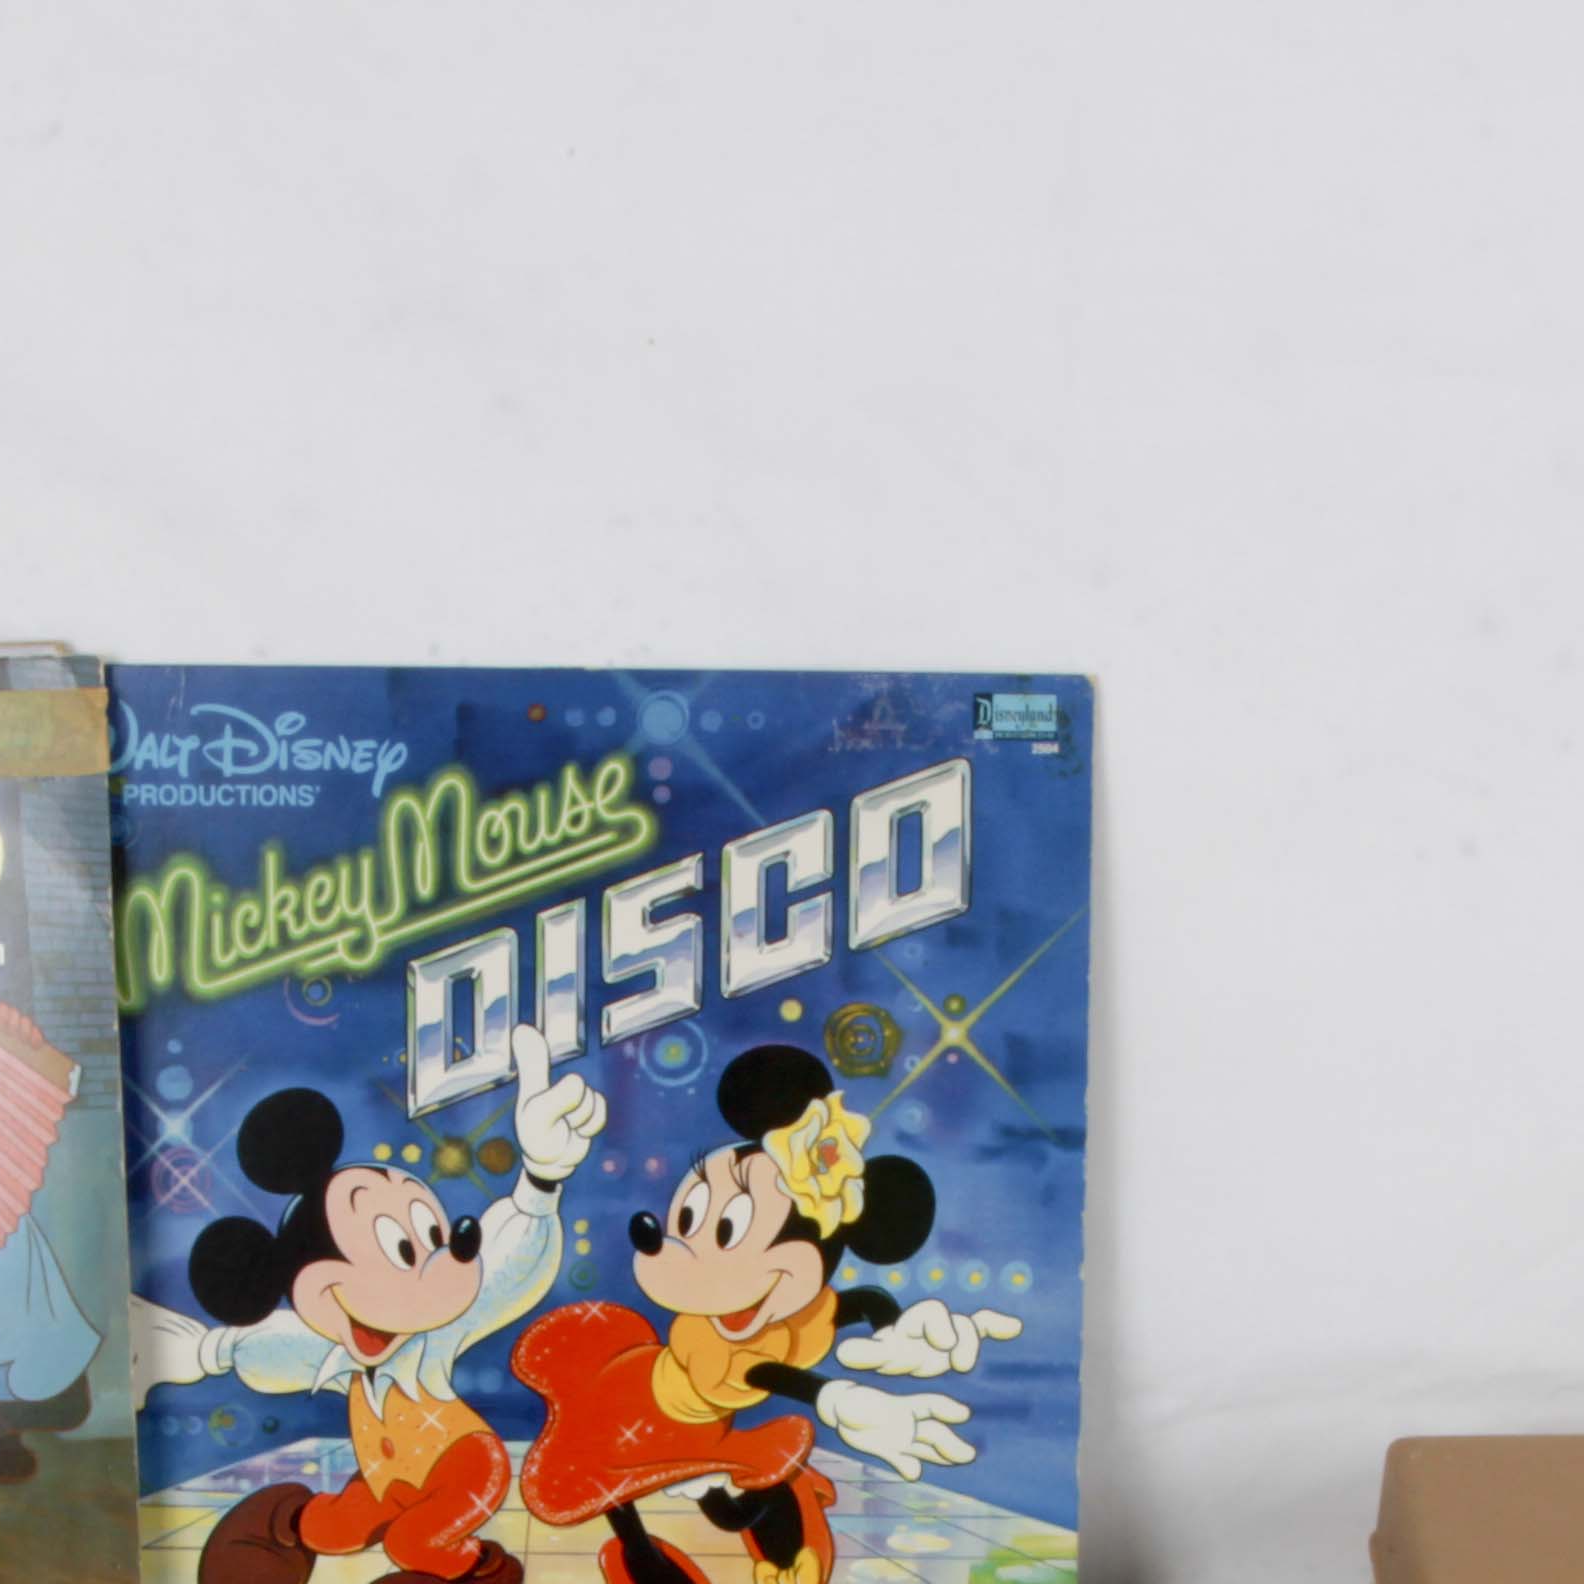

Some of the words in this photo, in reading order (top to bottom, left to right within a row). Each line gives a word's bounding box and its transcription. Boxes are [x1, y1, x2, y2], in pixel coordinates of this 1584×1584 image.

[119, 842, 408, 1008] Mickey
[384, 757, 656, 920] Mouse
[406, 756, 973, 1121] DISCO
